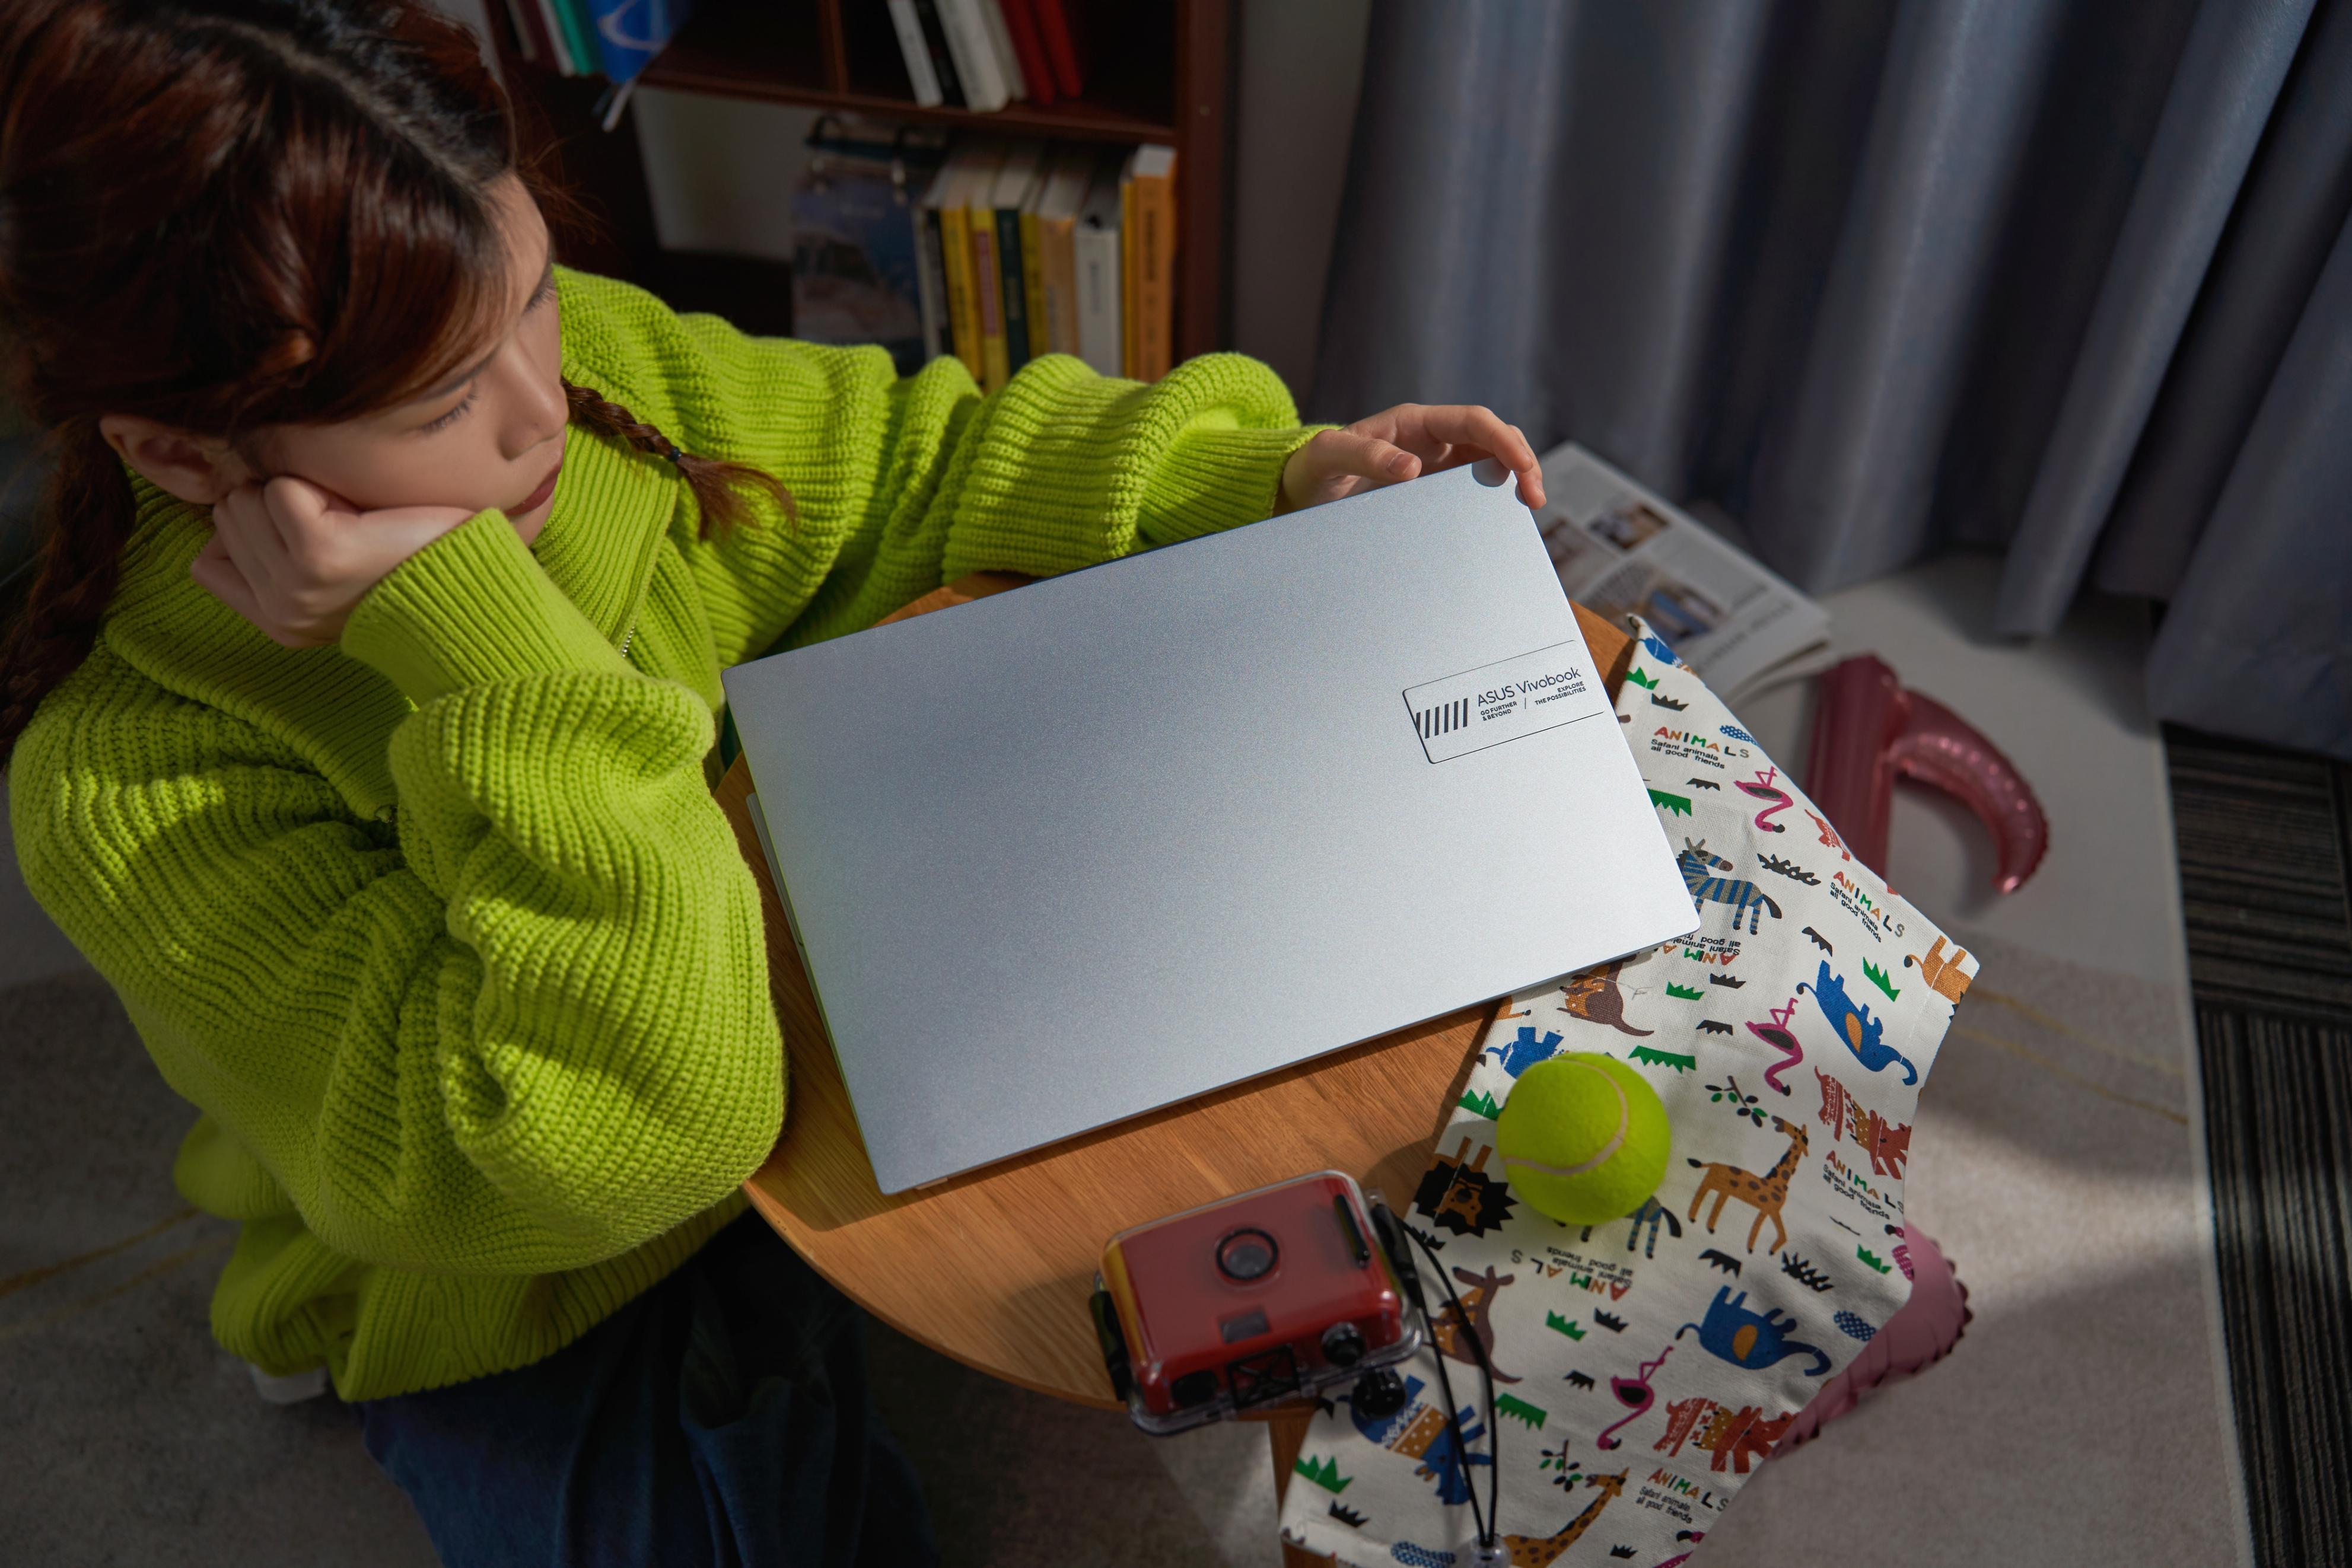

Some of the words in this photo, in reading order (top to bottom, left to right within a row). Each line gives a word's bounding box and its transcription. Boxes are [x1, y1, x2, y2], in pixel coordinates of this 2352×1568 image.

[1478, 686, 1515, 707] ASUS
[1516, 667, 1581, 693] Vivobook
[1547, 686, 1586, 702] POSSIBILITIES
[1557, 681, 1584, 693] EXPLORE
[1487, 709, 1511, 720] BEYOND
[1490, 701, 1517, 713] FURTHER
[1654, 726, 1749, 758] ANIMALS
[1665, 749, 1688, 758] good
[1695, 756, 1725, 769] friends
[1833, 871, 1905, 938] ANIMALS
[1830, 890, 1838, 900] all
[1841, 900, 1858, 917] good
[1862, 918, 1882, 943] friends
[1671, 938, 1706, 949] animal
[1701, 936, 1725, 945] good
[1653, 944, 1737, 966] ANIMA
[1647, 1467, 1729, 1512] ANIMALS
